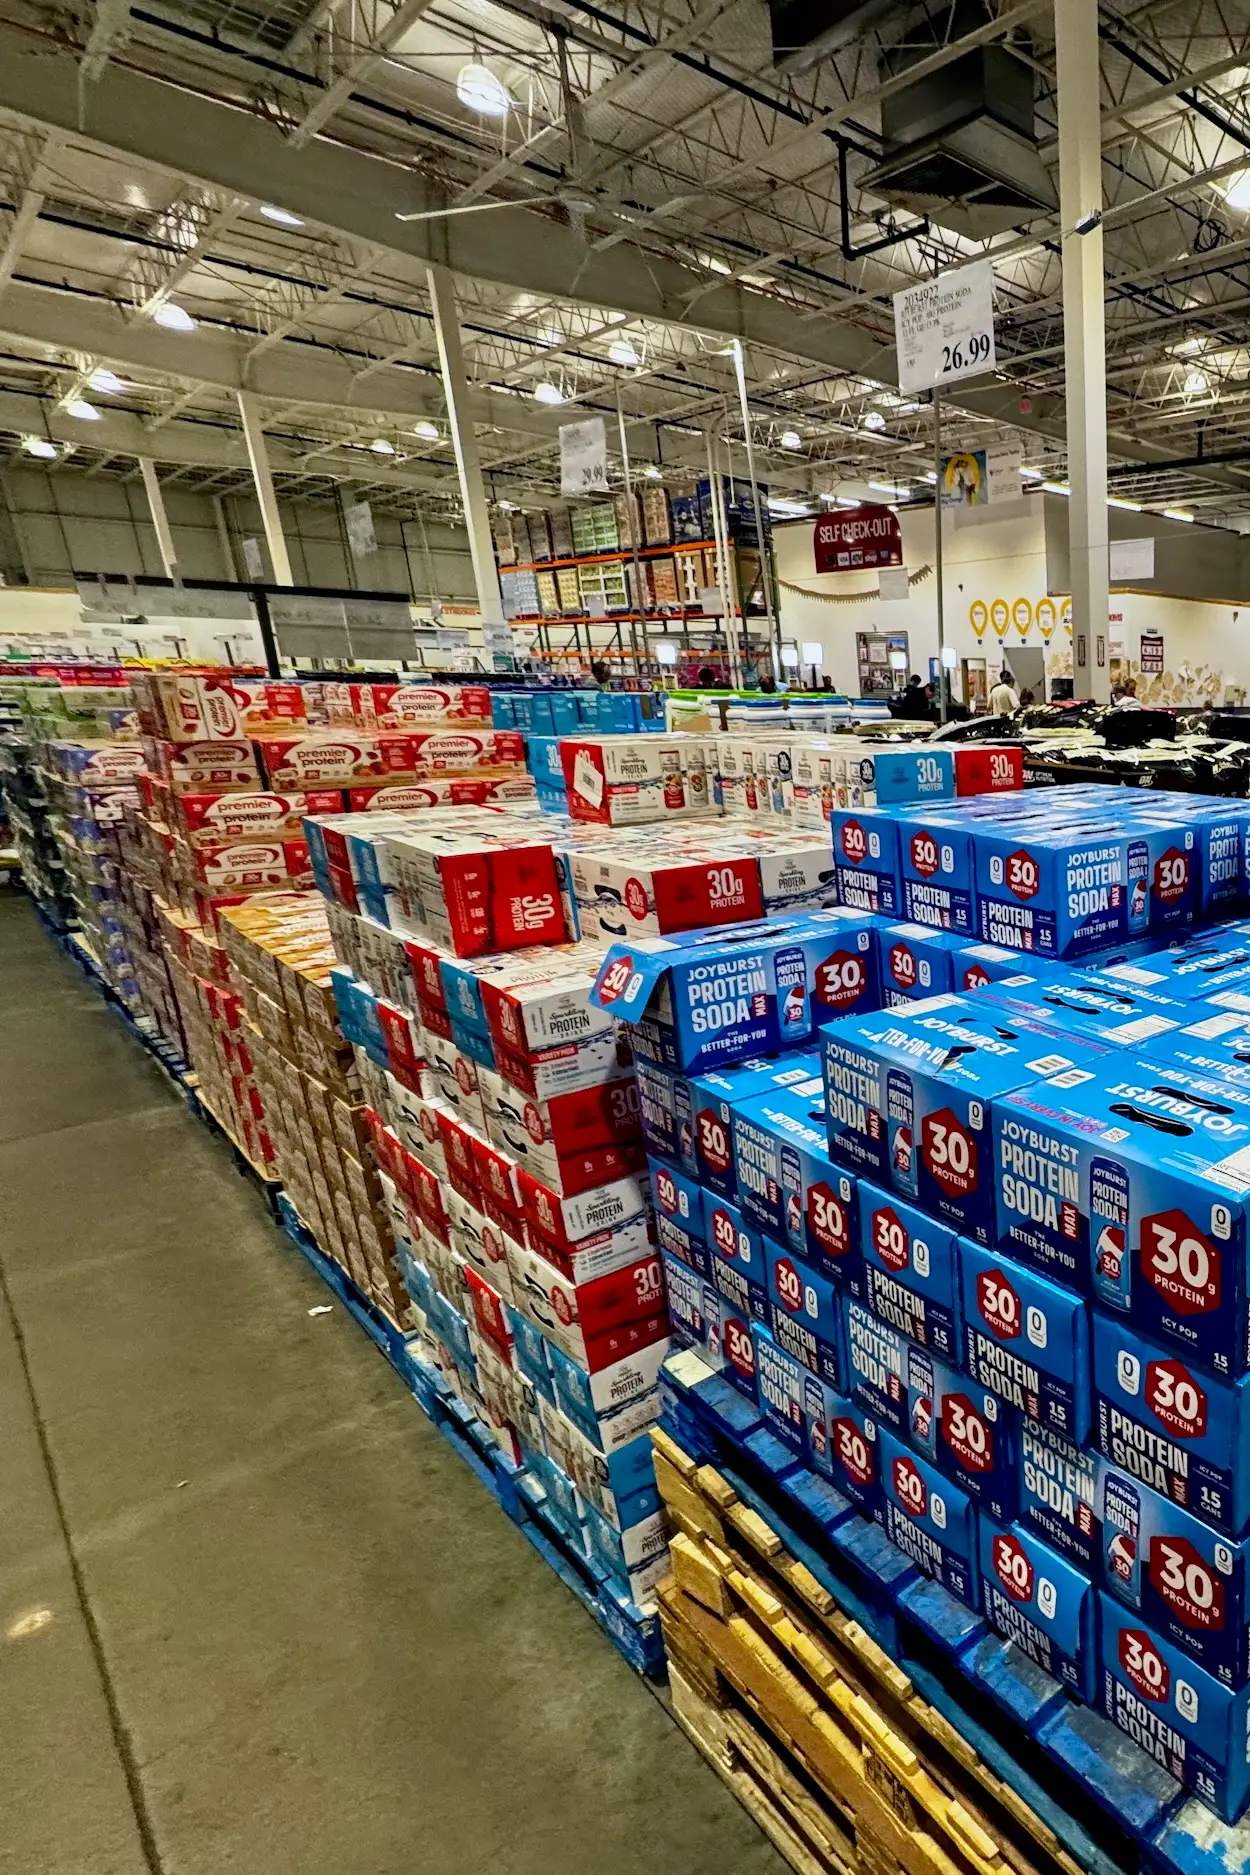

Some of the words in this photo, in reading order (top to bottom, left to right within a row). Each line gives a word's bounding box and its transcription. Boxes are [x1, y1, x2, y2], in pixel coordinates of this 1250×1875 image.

[942, 334, 990, 373] 26.99
[819, 525, 840, 544] SELF
[841, 516, 892, 541] CHECK-OUT
[398, 692, 437, 706] premier
[401, 702, 437, 714] protein
[297, 747, 348, 763] premier
[428, 738, 470, 753] premier
[431, 749, 468, 761] protein
[302, 756, 346, 769] protein
[620, 763, 649, 775] PROTEIN
[915, 757, 943, 784] 30g
[990, 755, 1015, 780] 30g
[917, 781, 944, 793] PROTEIN
[217, 799, 274, 817] premier
[224, 811, 271, 825] protein
[1066, 846, 1121, 869] JOYBURST
[707, 870, 744, 900] 30g
[843, 868, 878, 892] PROTEIN
[1067, 861, 1122, 892] PROTEIN
[709, 894, 746, 909] PROTEIN
[882, 892, 892, 903] 15
[1068, 889, 1110, 919] SODA
[513, 897, 525, 932] PROTEIN
[521, 893, 553, 931] 30g
[1073, 919, 1119, 940] BETTER-FOR-YOU
[686, 955, 764, 983] JOYBURST
[822, 959, 865, 994] 30g
[688, 967, 767, 1008] PROTEIN
[826, 988, 860, 1002] PROTEIN
[549, 1007, 587, 1021] Sparkling
[549, 1016, 591, 1035] PROTEIN
[691, 1001, 752, 1033] SODA
[701, 1028, 767, 1055] BETTER-FOR-YOU
[913, 1017, 1020, 1057] JOYBURST
[825, 1041, 881, 1077] JOYBURST
[826, 1061, 881, 1109] PROTEIN
[1104, 1082, 1250, 1136] JOYBURST
[929, 1122, 975, 1179] 30g
[1000, 1119, 1080, 1160] JOYBURST
[932, 1165, 968, 1189] PROTEIN
[1000, 1139, 1080, 1205] PROTEIN
[1002, 1177, 1060, 1232] SODA
[1062, 1207, 1079, 1238] MAX
[1009, 1224, 1076, 1270] BETTER-FOR-YOU
[1151, 1222, 1216, 1296] 30g
[1154, 1274, 1206, 1308] PROTEIN
[1161, 1315, 1178, 1331] ICY
[1178, 1321, 1198, 1338] POP
